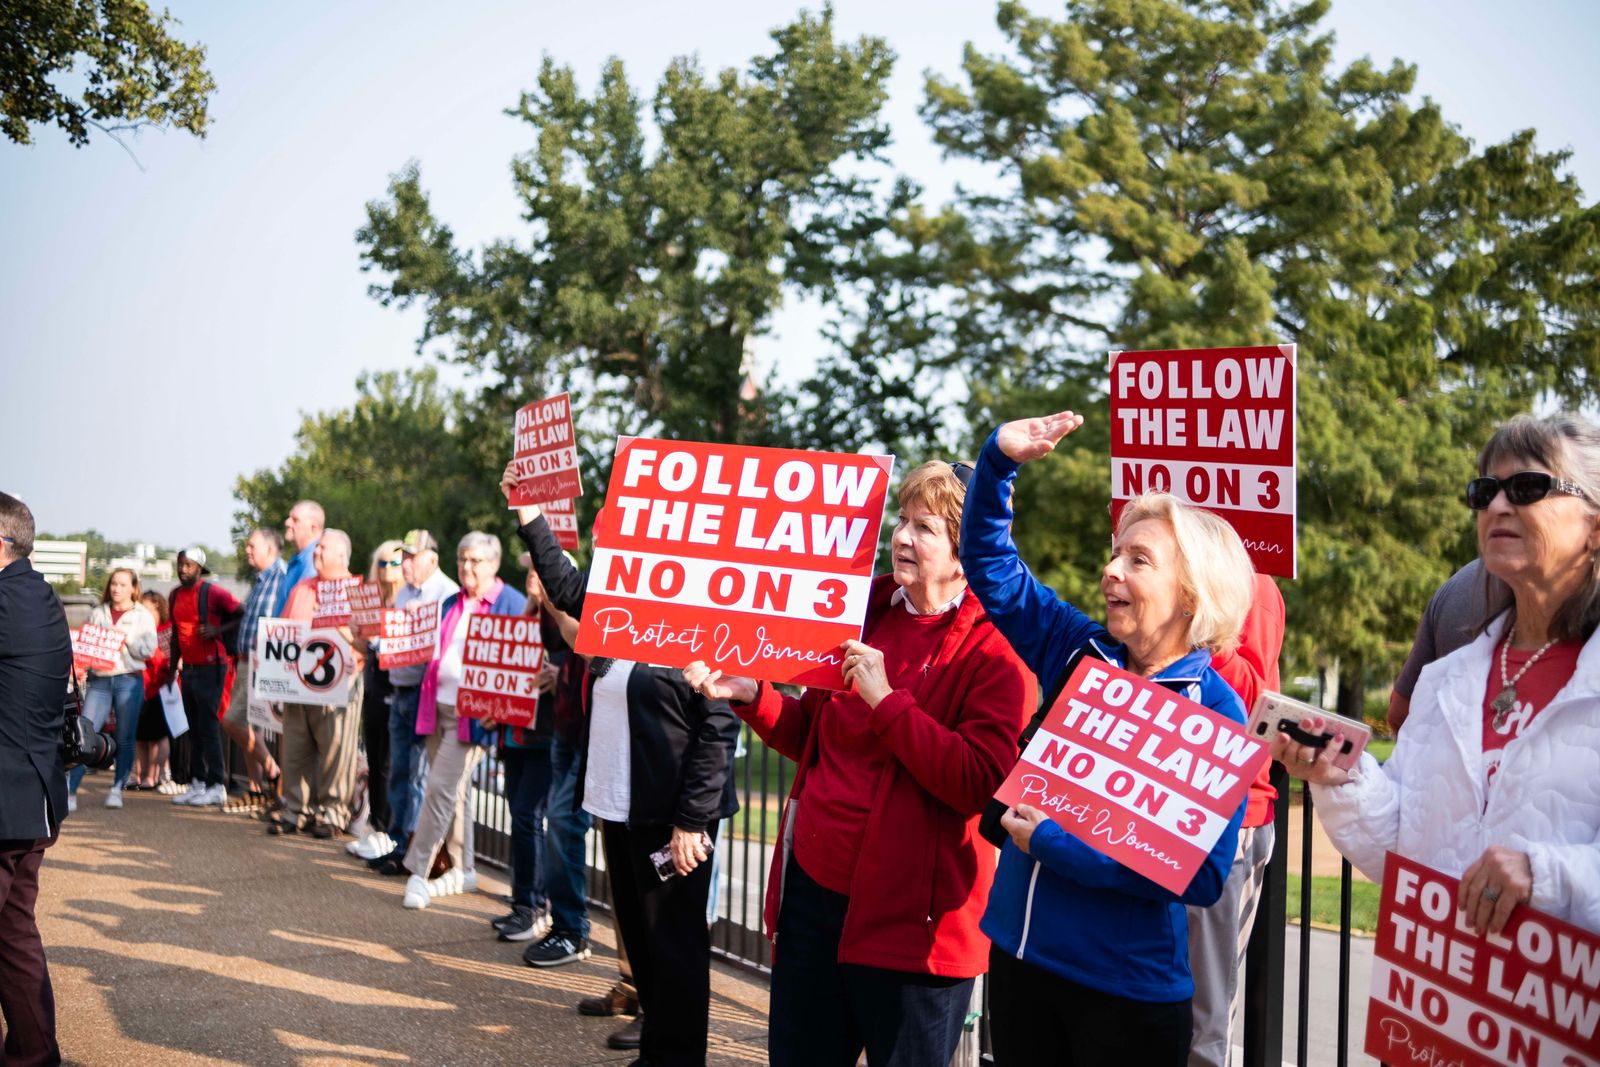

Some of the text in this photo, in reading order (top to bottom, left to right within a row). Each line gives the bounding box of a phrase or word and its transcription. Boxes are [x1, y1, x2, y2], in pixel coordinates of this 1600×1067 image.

[1118, 357, 1286, 400] FOLLOW
[539, 422, 569, 447] LAW
[1118, 408, 1285, 450] THE LAW
[516, 450, 573, 477] NO ON 3
[623, 448, 880, 508] FOLLOW
[1122, 463, 1280, 509] NO ON 3
[616, 496, 869, 559] THE LAW
[1242, 538, 1283, 554] men
[605, 555, 848, 618] NO ON 3
[266, 625, 302, 643] VOTE
[384, 622, 412, 637] THE
[387, 641, 405, 650] NO
[470, 616, 542, 644] FOLLOW
[593, 607, 841, 667] Protect Women
[265, 641, 336, 687] NO 3
[467, 639, 542, 669] THE LAW
[464, 669, 488, 688] NO
[494, 673, 518, 692] ON
[1078, 666, 1261, 768] FOLLOW
[1062, 698, 1240, 800] THE LAW
[1039, 738, 1207, 837] NO ON 3
[1020, 773, 1182, 871] Protect Women
[1390, 912, 1600, 1040] THE LAW
[1387, 968, 1540, 1067] NO ON
